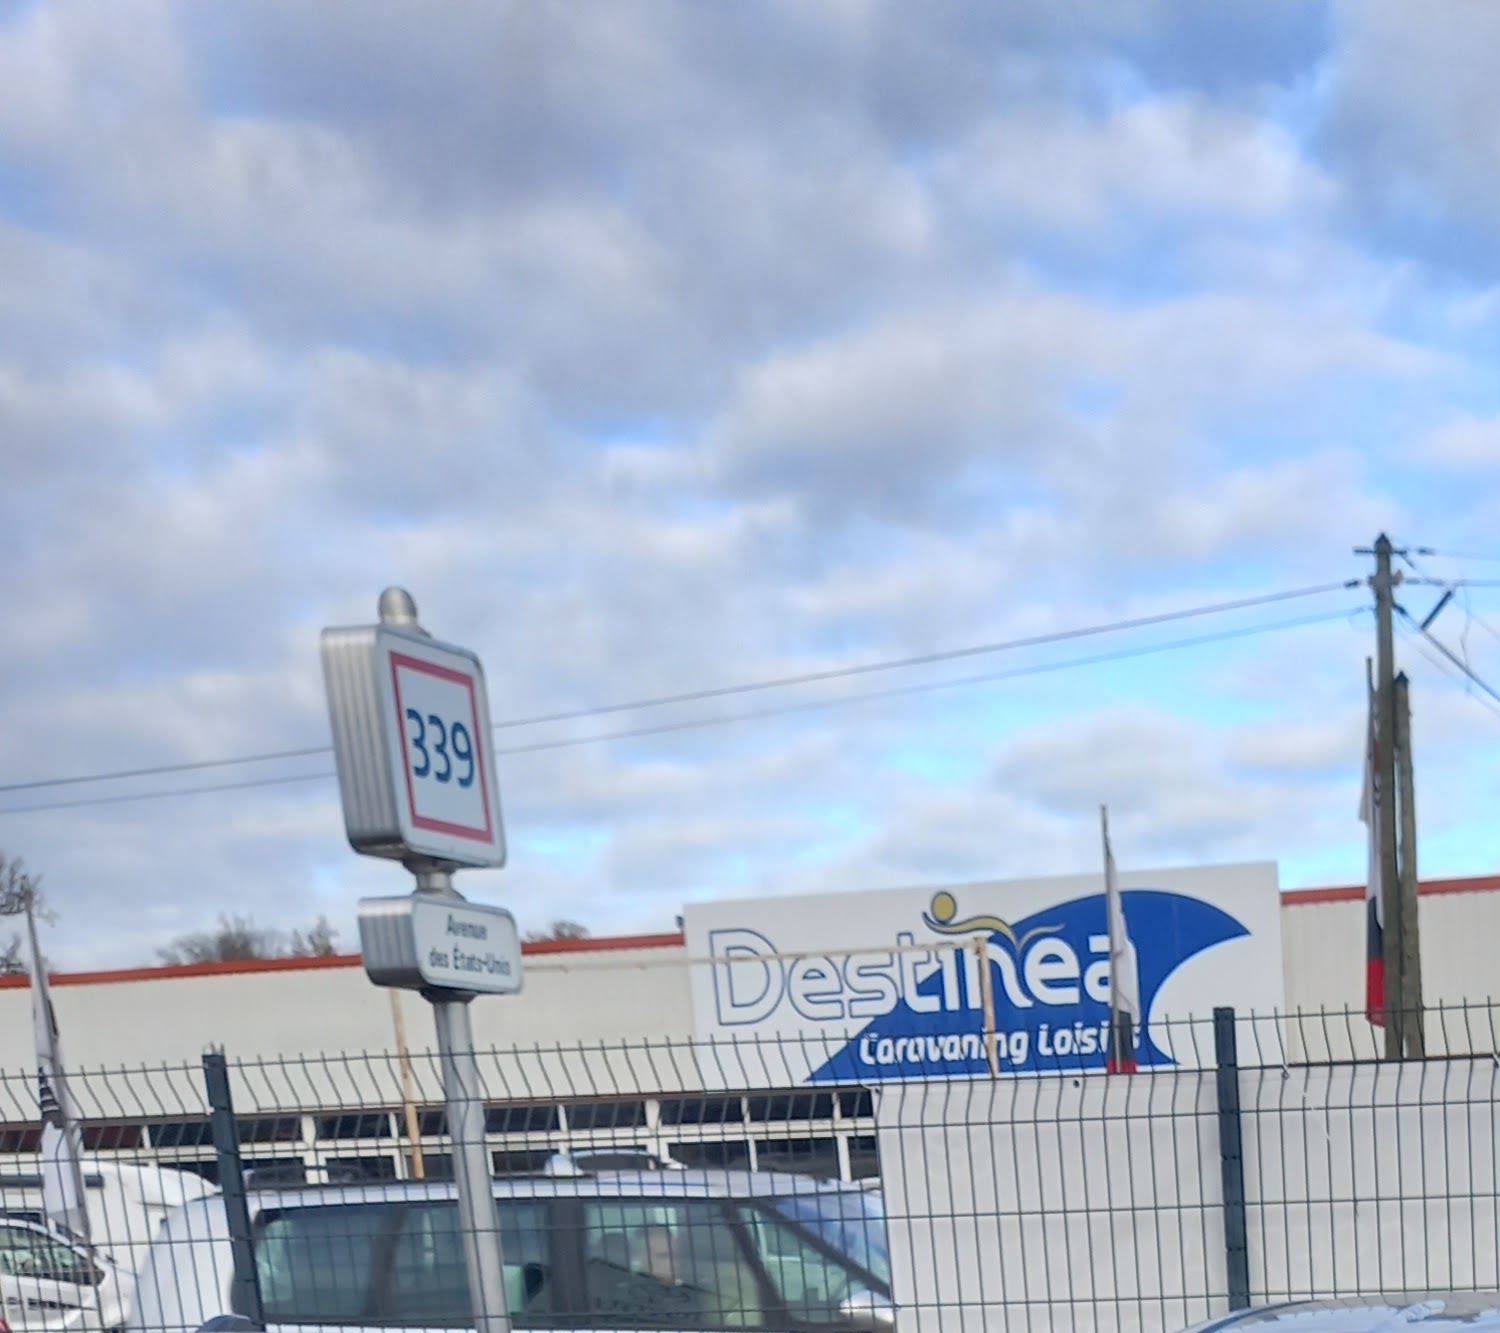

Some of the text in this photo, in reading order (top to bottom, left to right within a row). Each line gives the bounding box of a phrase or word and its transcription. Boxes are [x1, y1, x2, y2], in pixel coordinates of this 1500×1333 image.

[405, 708, 476, 789] 339
[446, 914, 487, 940] Avenue
[429, 946, 449, 968] des
[708, 927, 1113, 1026] Destinea
[1037, 1020, 1141, 1056] Loisi
